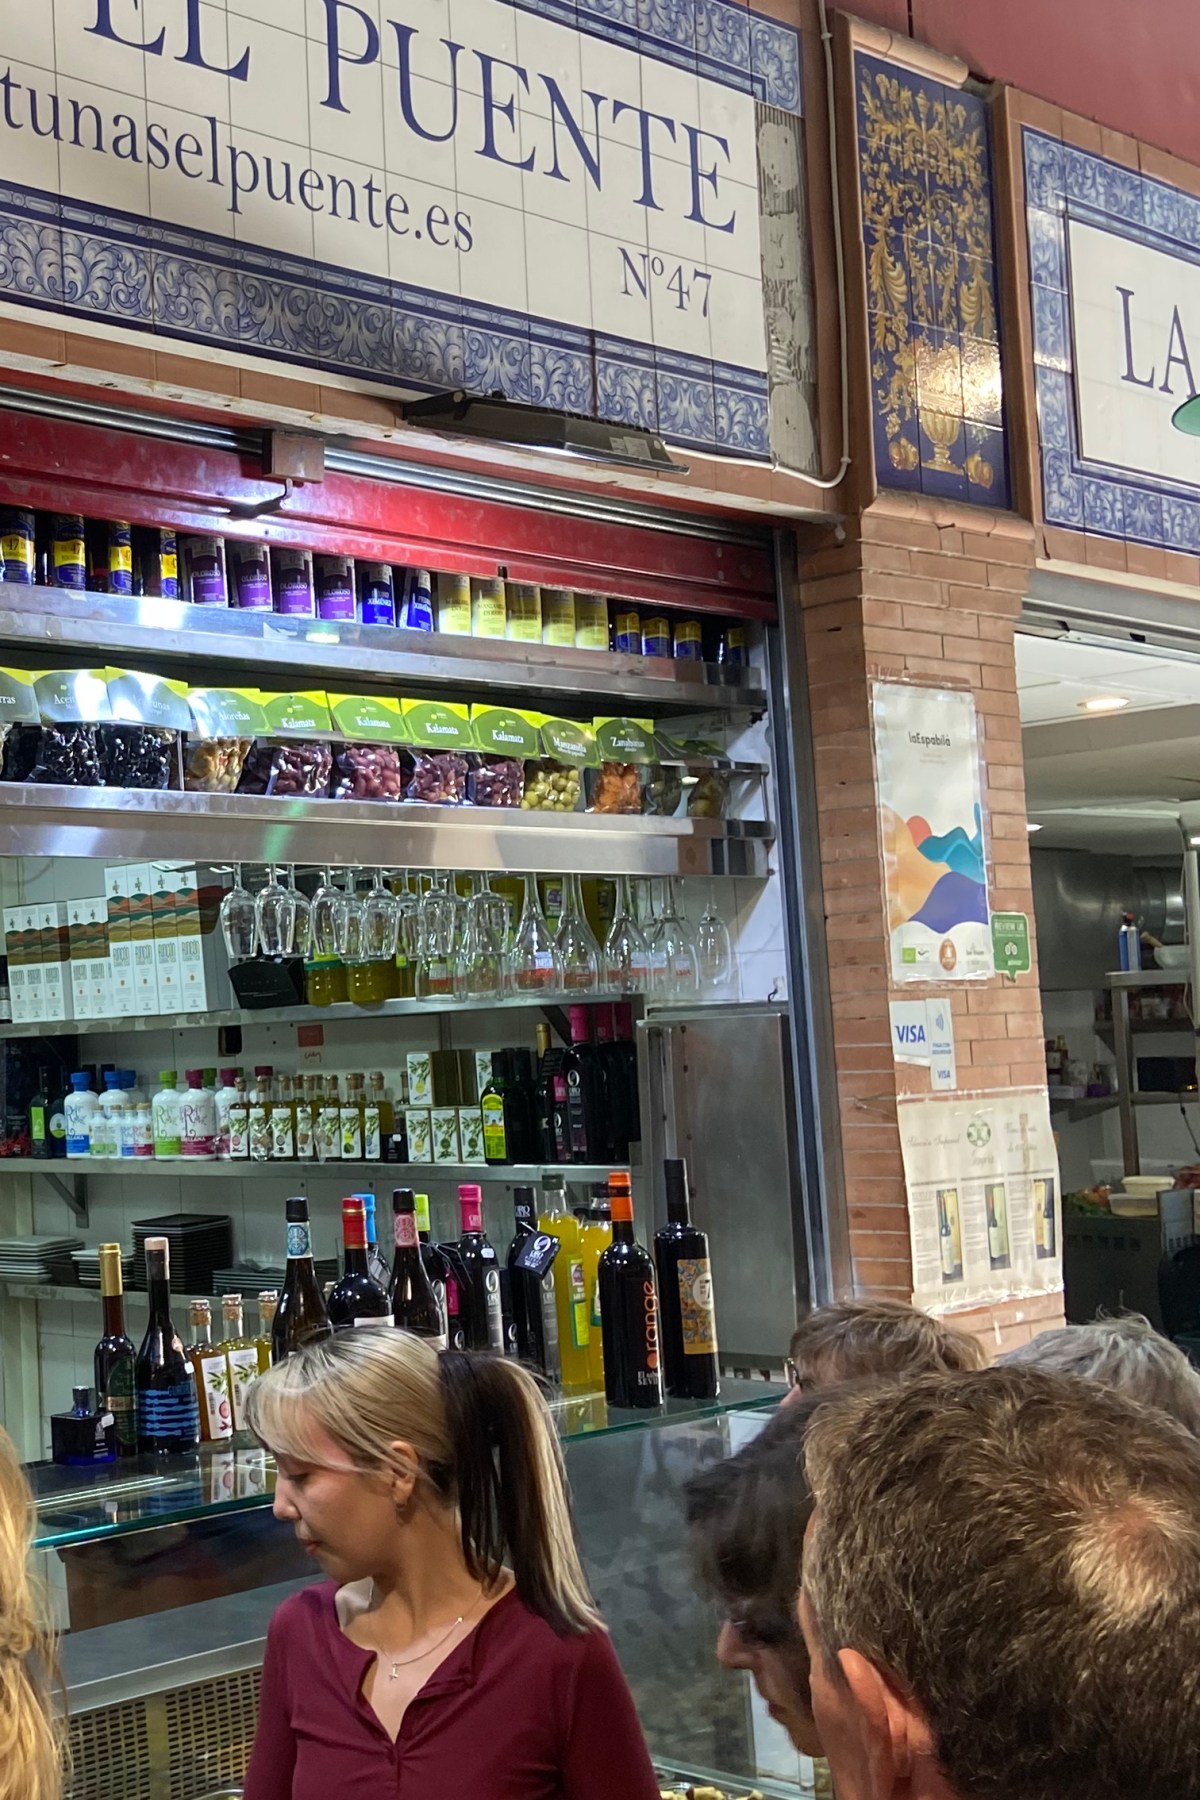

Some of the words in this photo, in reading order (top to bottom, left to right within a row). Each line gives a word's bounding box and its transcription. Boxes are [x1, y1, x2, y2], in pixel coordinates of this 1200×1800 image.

[320, 0, 737, 234] PUENTE
[1115, 286, 1198, 398] LA
[281, 717, 316, 728] Kalamata
[355, 716, 391, 728] Kalamata
[425, 722, 459, 735] Kalamata
[491, 730, 524, 744] Kalamata
[895, 1025, 927, 1044] VISA
[937, 1070, 951, 1079] VISA
